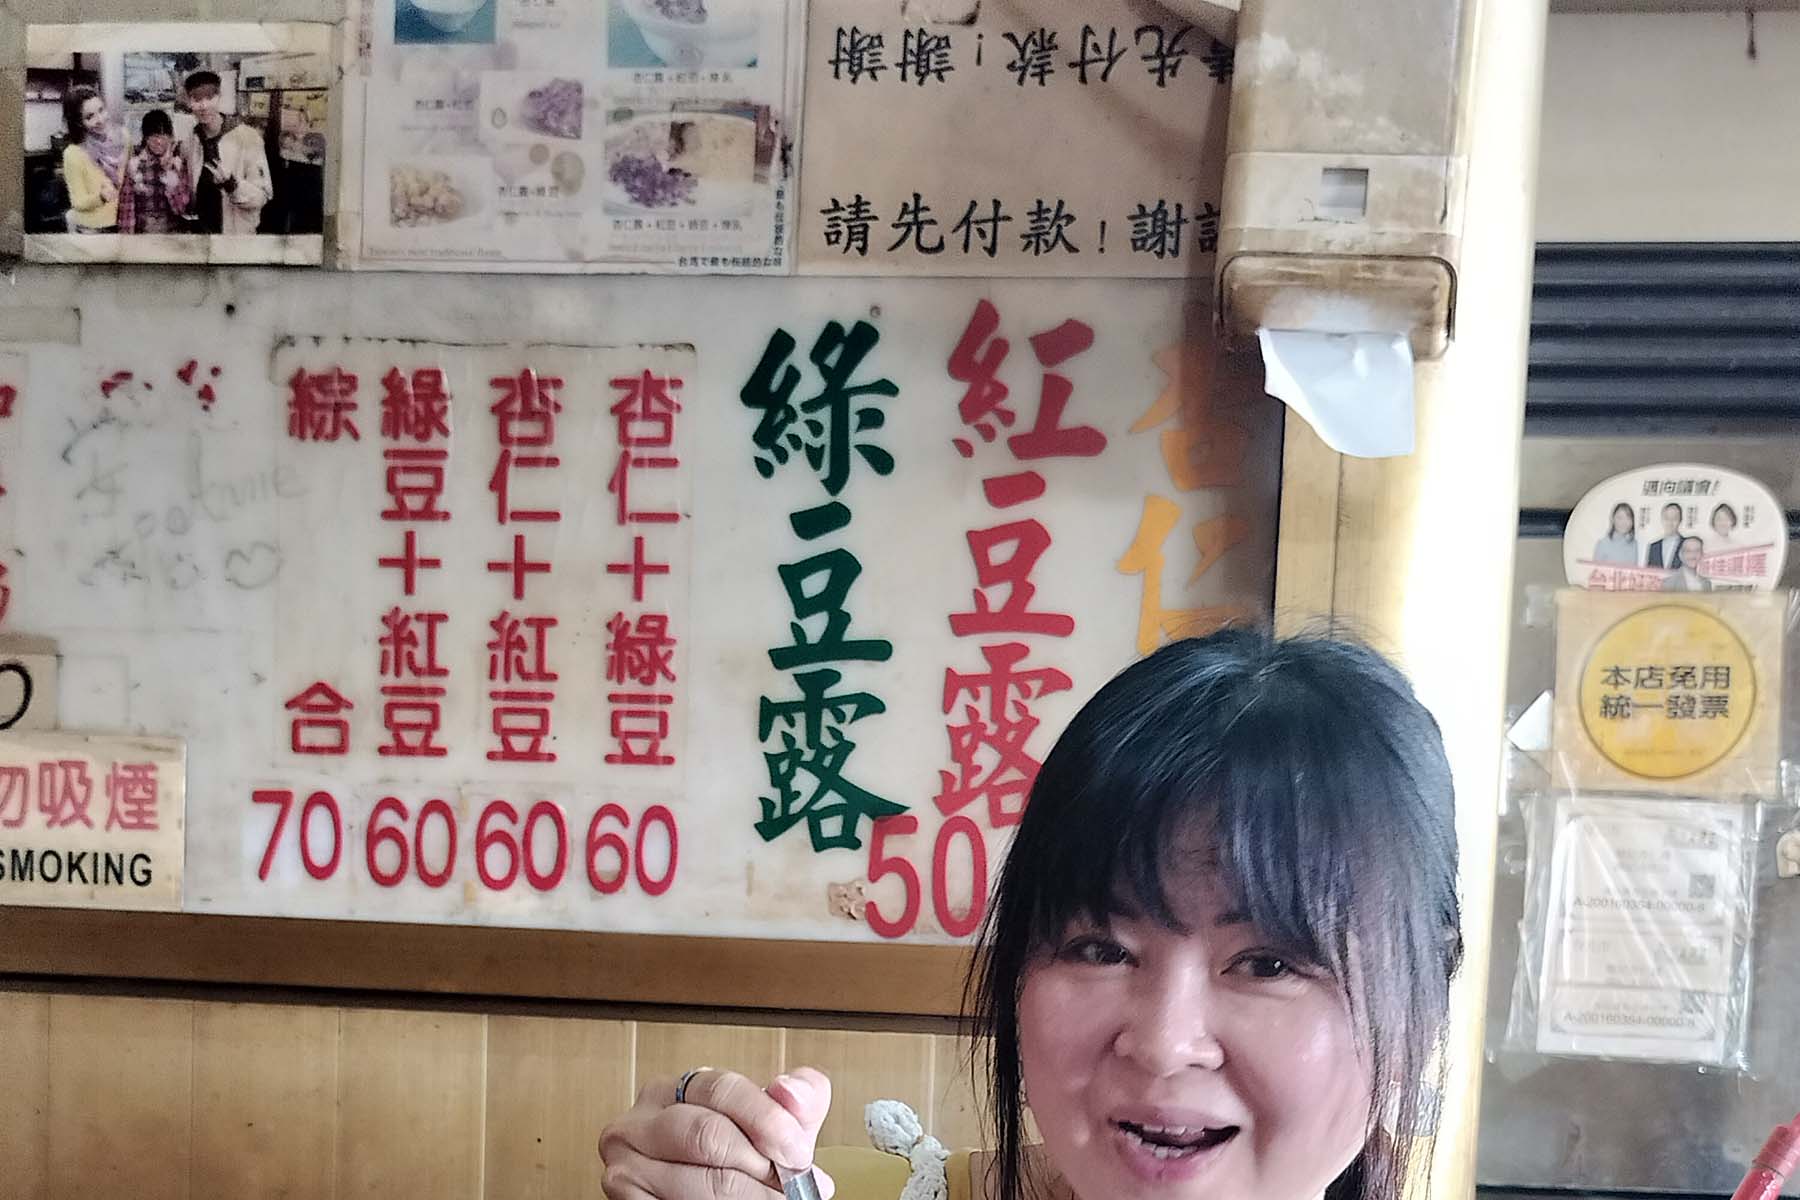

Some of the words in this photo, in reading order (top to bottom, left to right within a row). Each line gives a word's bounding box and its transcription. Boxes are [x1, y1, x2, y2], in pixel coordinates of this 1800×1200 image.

[739, 319, 911, 853] 綠豆露
[932, 298, 1108, 828] 紅豆露
[1599, 694, 1730, 720] 統一發票
[1600, 664, 1731, 690] 本店免用
[0, 848, 153, 888] MOKING
[252, 790, 343, 881] 70
[366, 796, 458, 888] 60
[475, 800, 567, 892] 60
[586, 802, 679, 897] 60
[864, 814, 987, 939] 50
